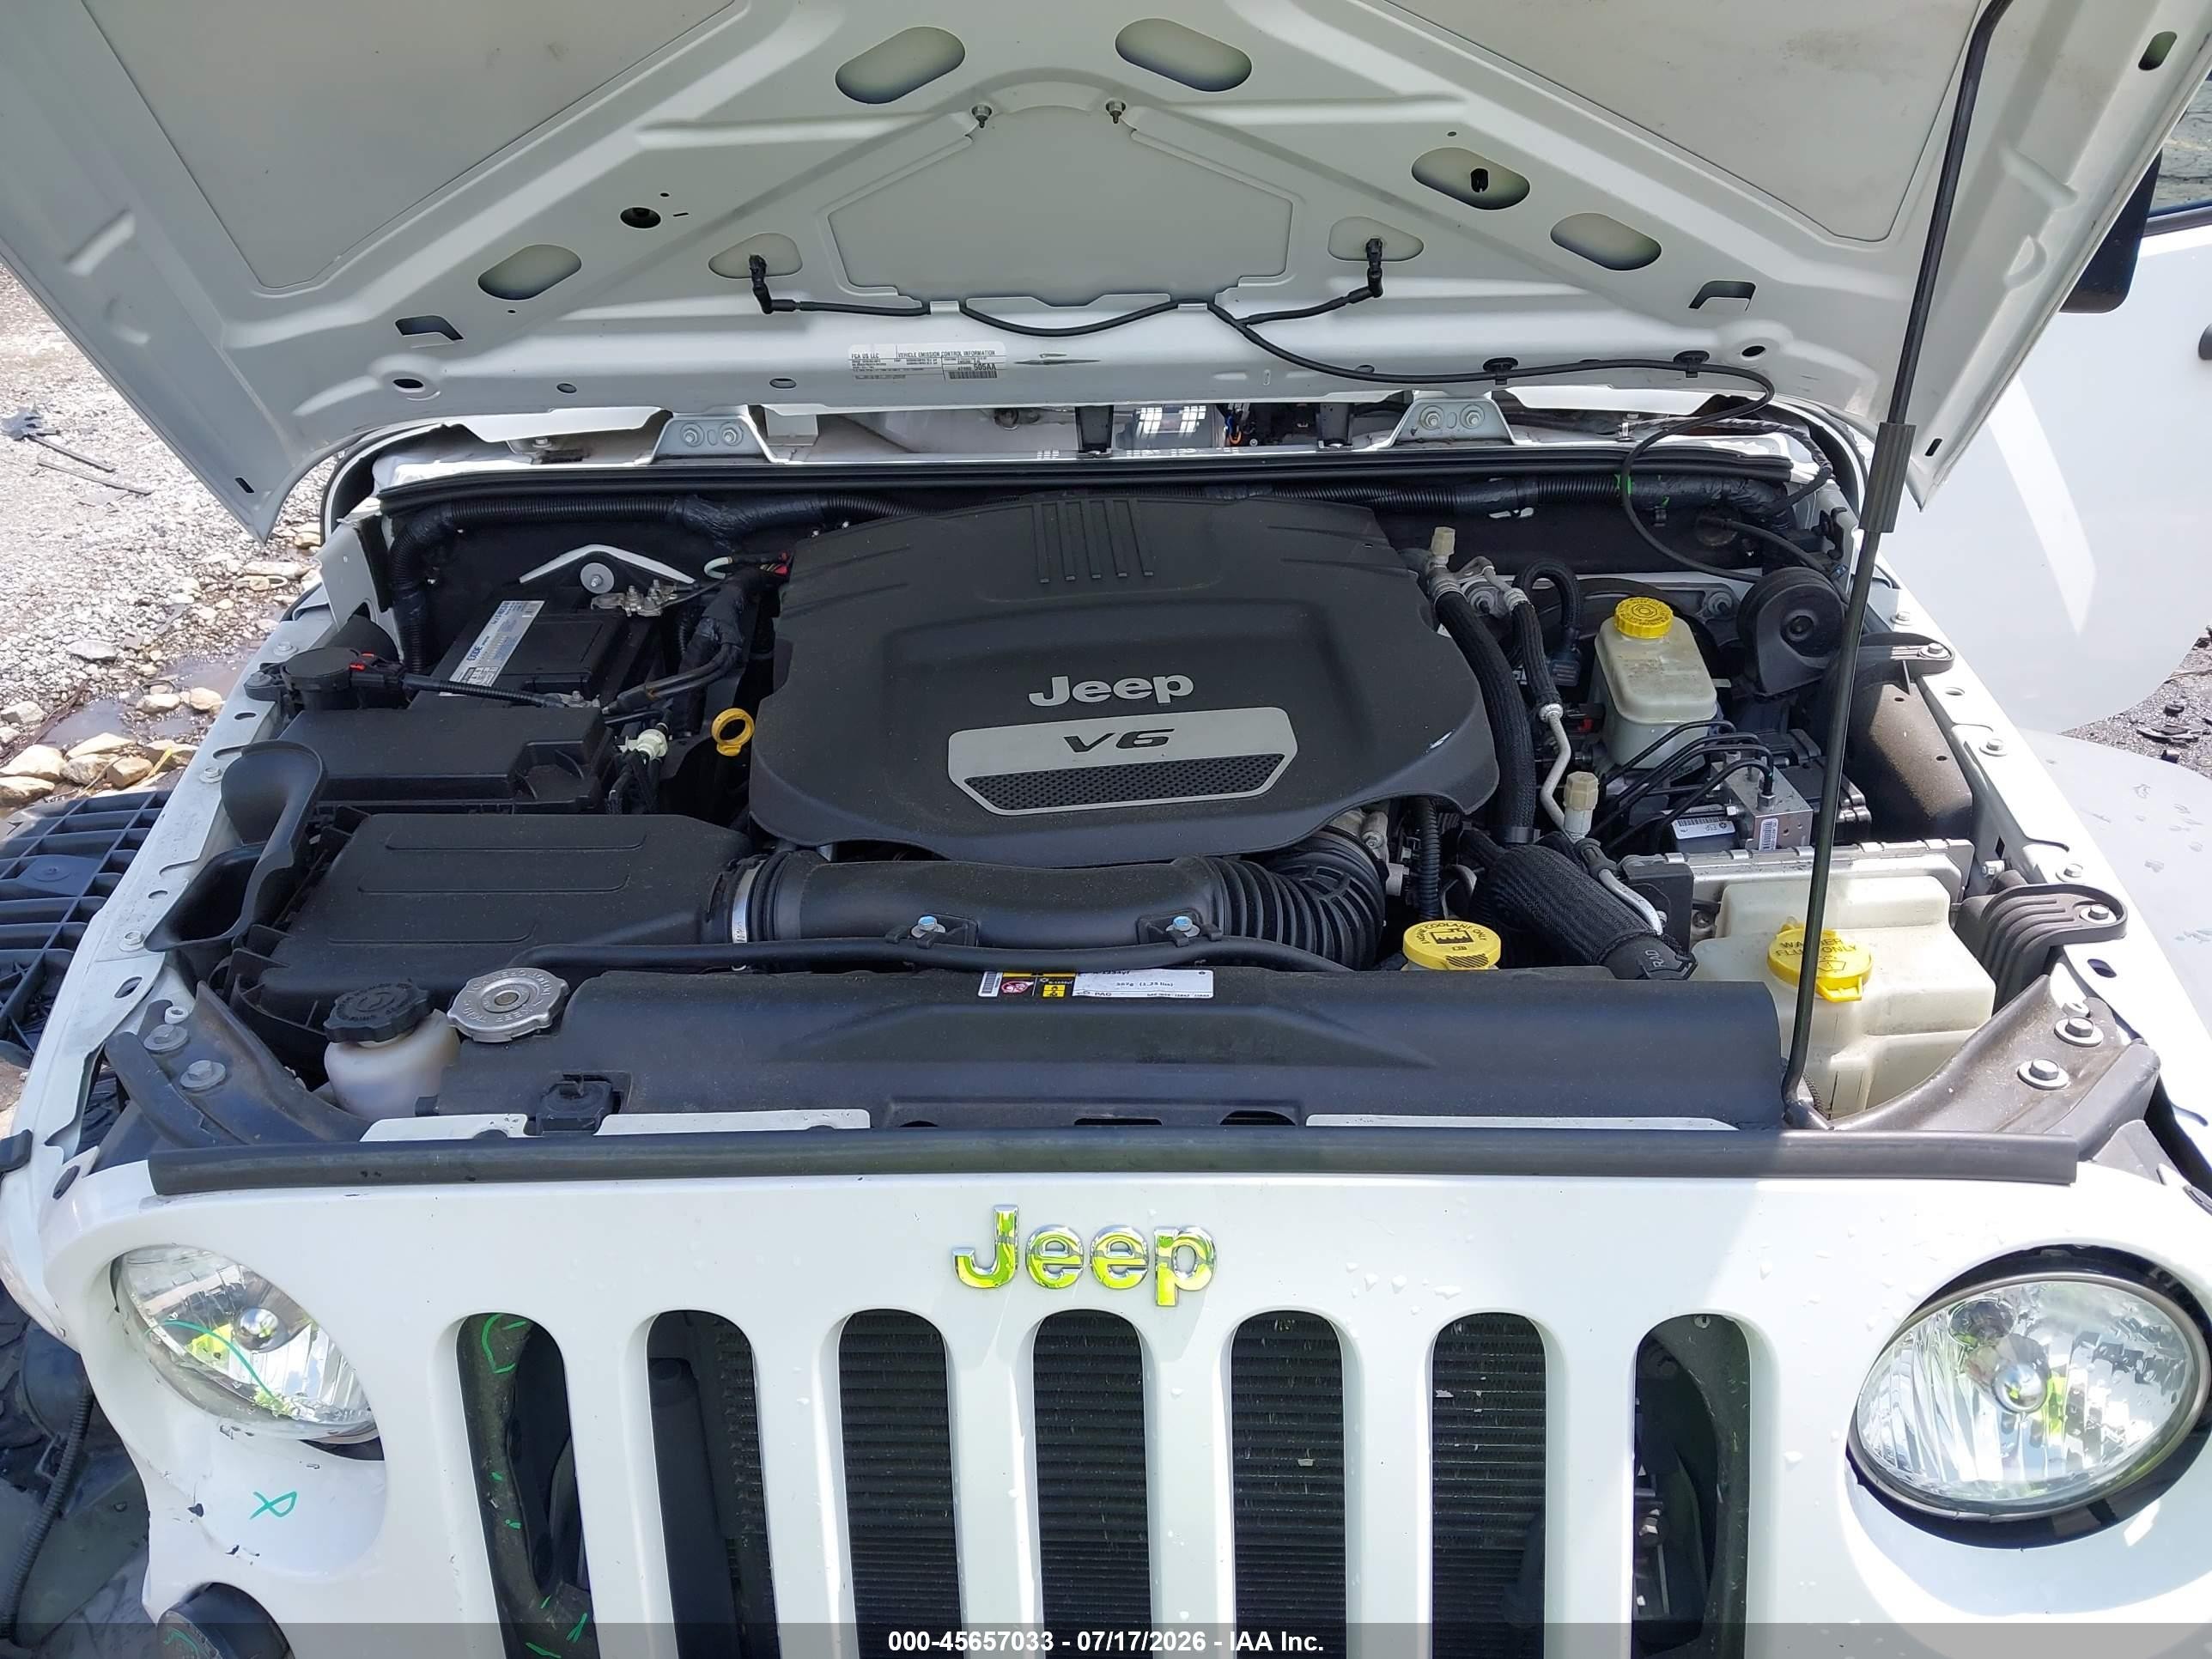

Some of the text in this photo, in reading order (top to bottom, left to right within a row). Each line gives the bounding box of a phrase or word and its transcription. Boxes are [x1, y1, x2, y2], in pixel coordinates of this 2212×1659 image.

[1028, 673, 1194, 708] Jeep
[1063, 727, 1176, 754] V6
[1779, 939, 1844, 948] WAER
[1821, 945, 1856, 953] ONLY
[1644, 950, 1667, 968] RAD
[951, 1204, 1218, 1307] Jeep
